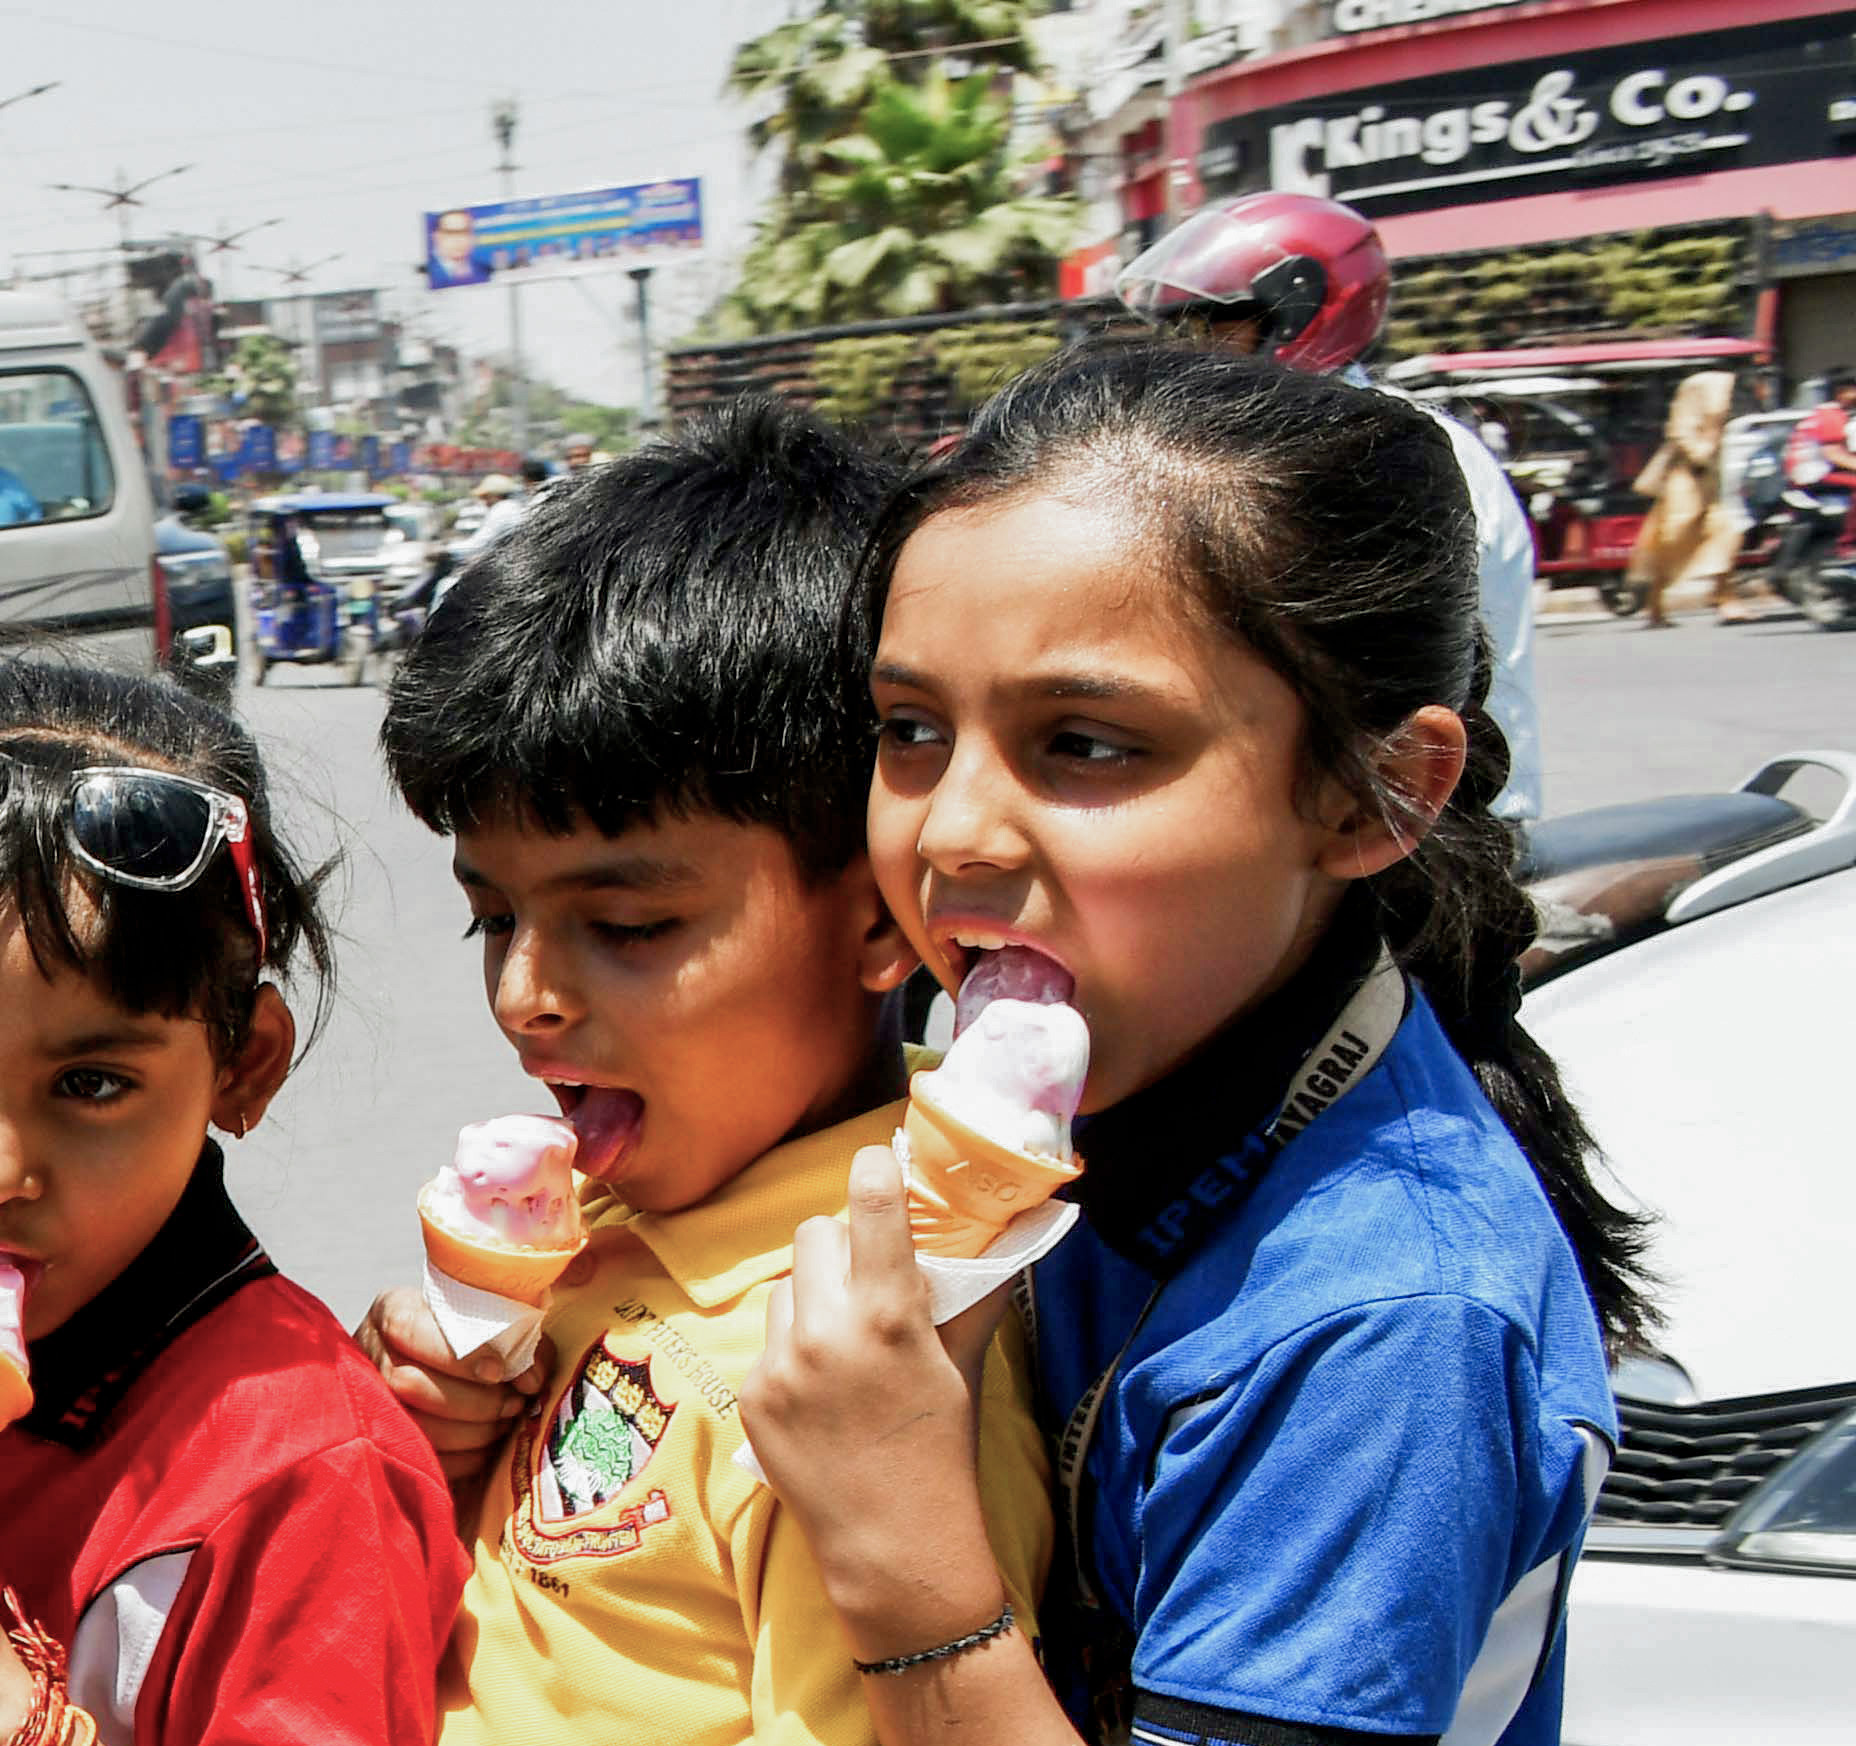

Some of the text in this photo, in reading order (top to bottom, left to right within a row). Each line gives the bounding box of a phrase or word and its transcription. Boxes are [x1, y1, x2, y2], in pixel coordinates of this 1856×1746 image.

[1325, 100, 1510, 169] Kings
[1508, 70, 1599, 153] &
[1610, 69, 1755, 126] Co.
